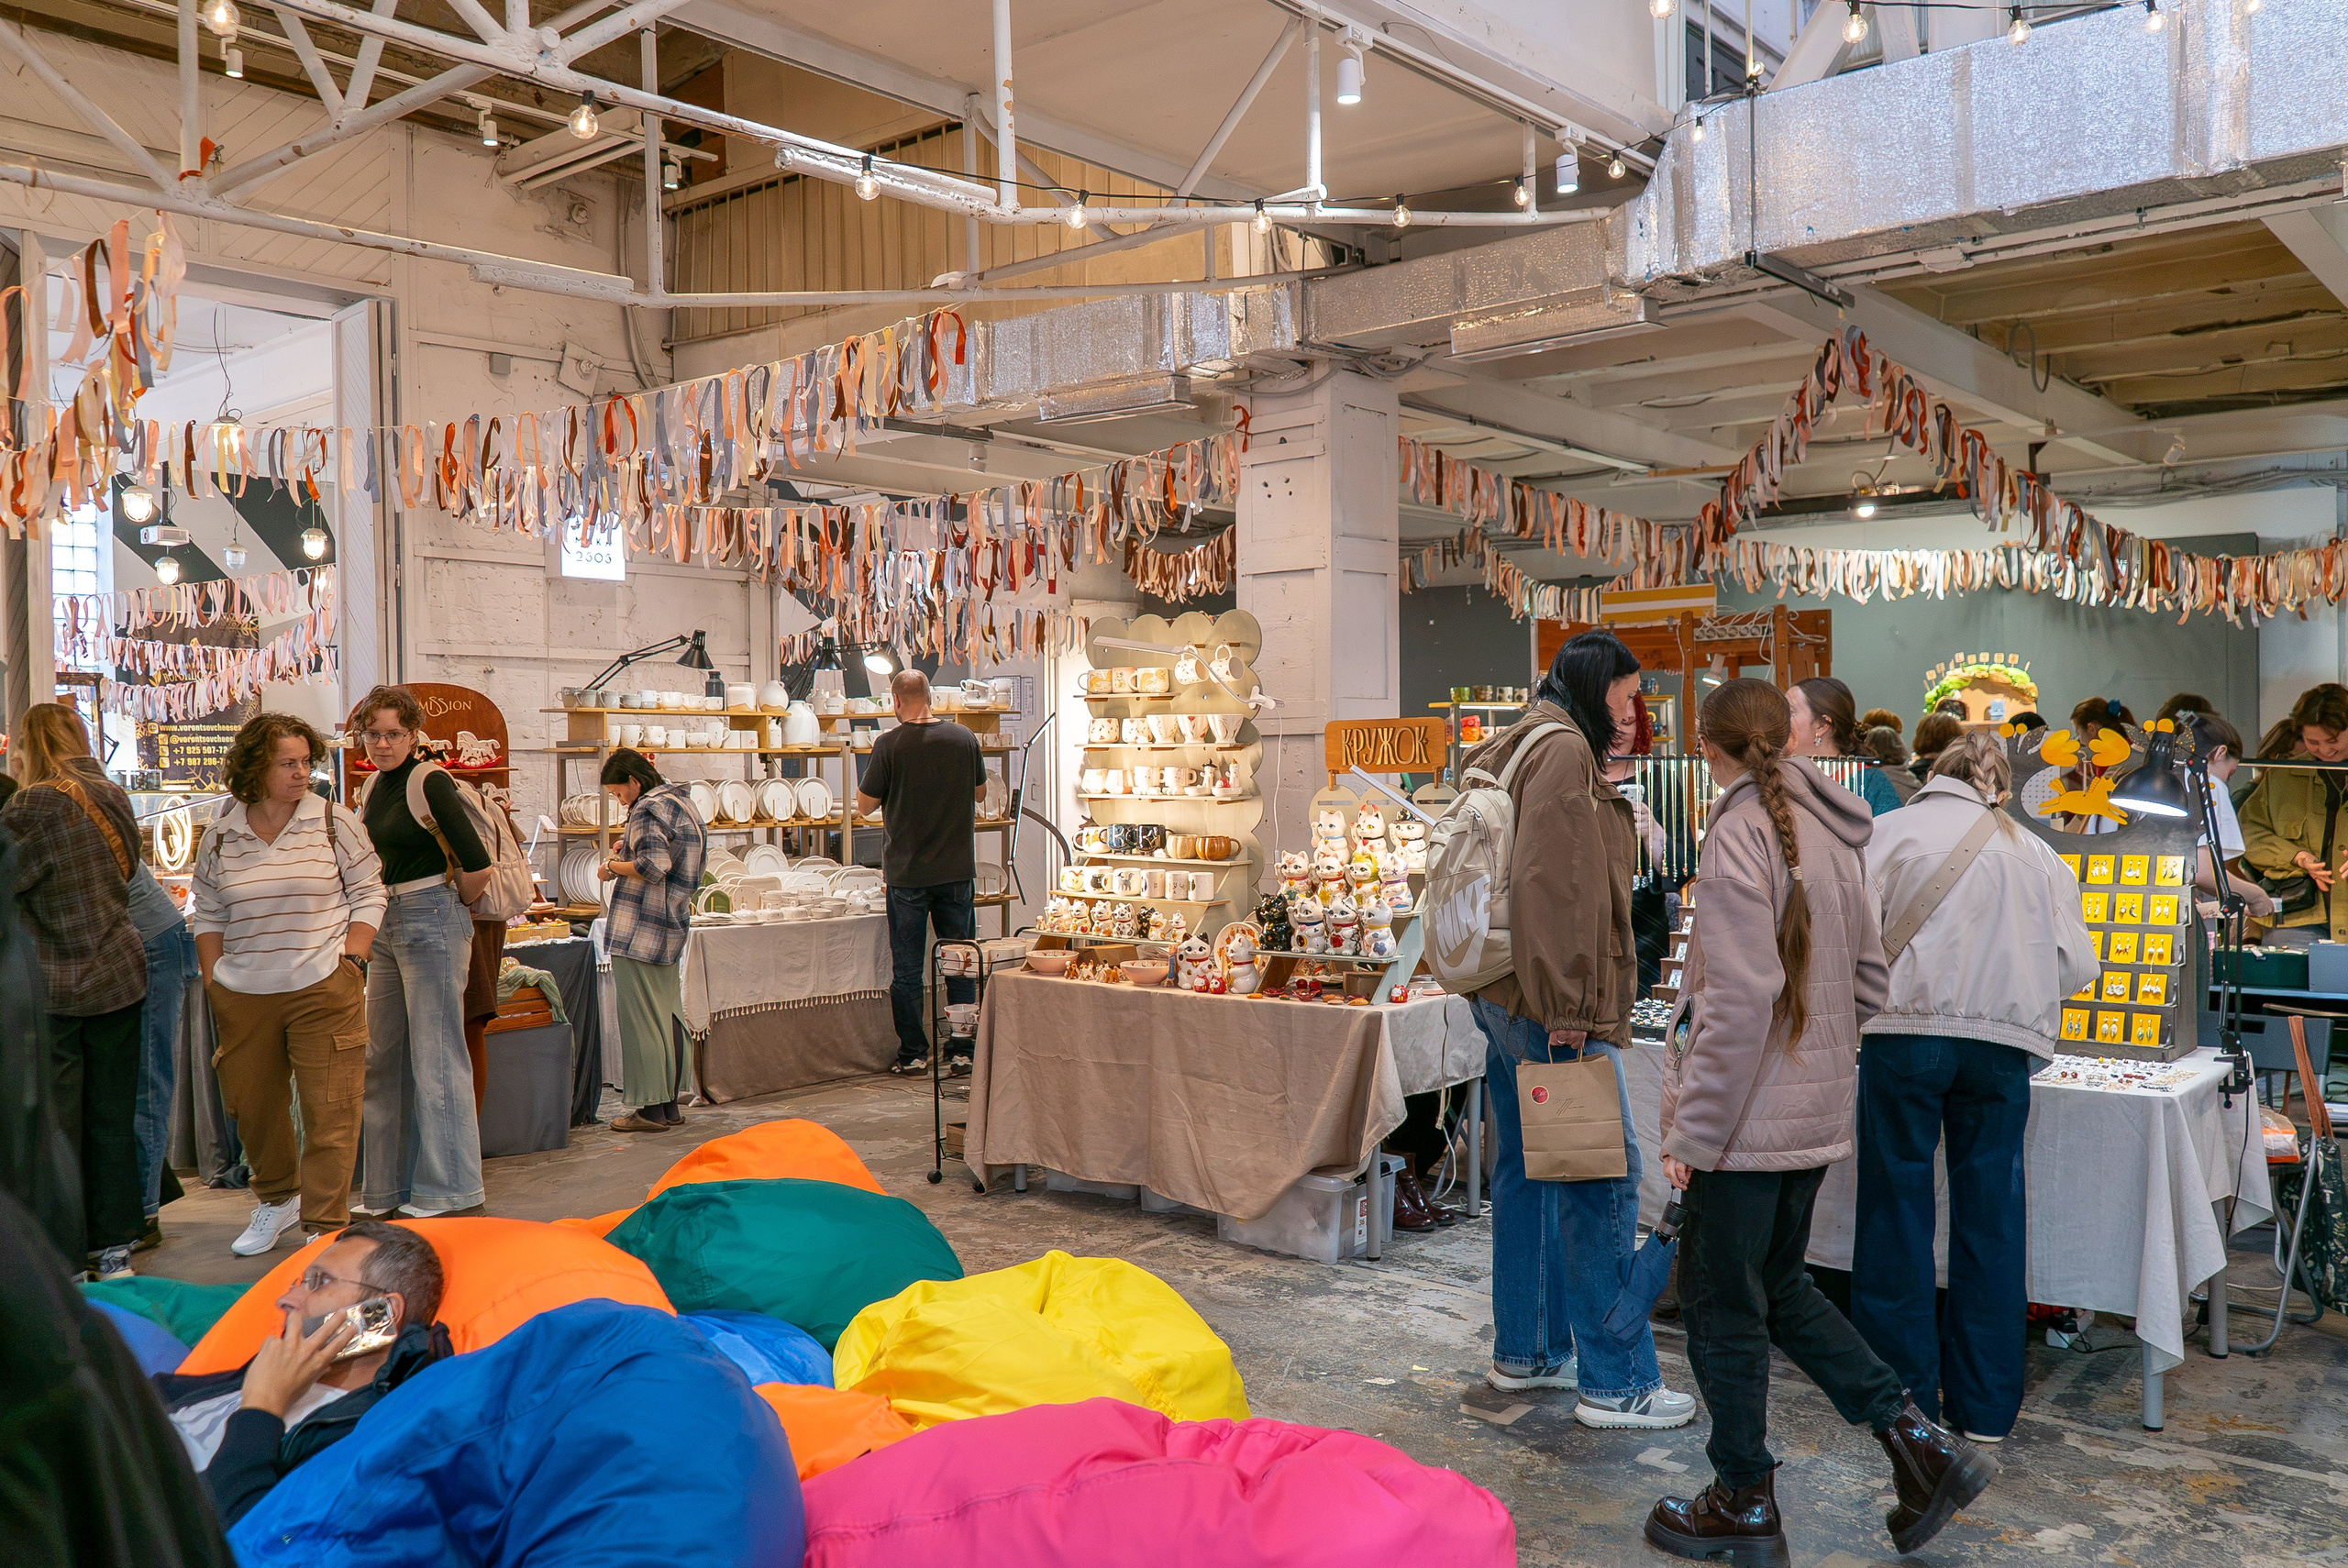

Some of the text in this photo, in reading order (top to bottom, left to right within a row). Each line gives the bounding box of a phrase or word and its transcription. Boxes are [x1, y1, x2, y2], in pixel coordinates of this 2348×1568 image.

[172, 745, 184, 755] +7
[186, 745, 201, 755] 925
[1341, 726, 1428, 766] КРУЖОК
[173, 757, 185, 767] +7
[1434, 873, 1490, 958] NIKE
